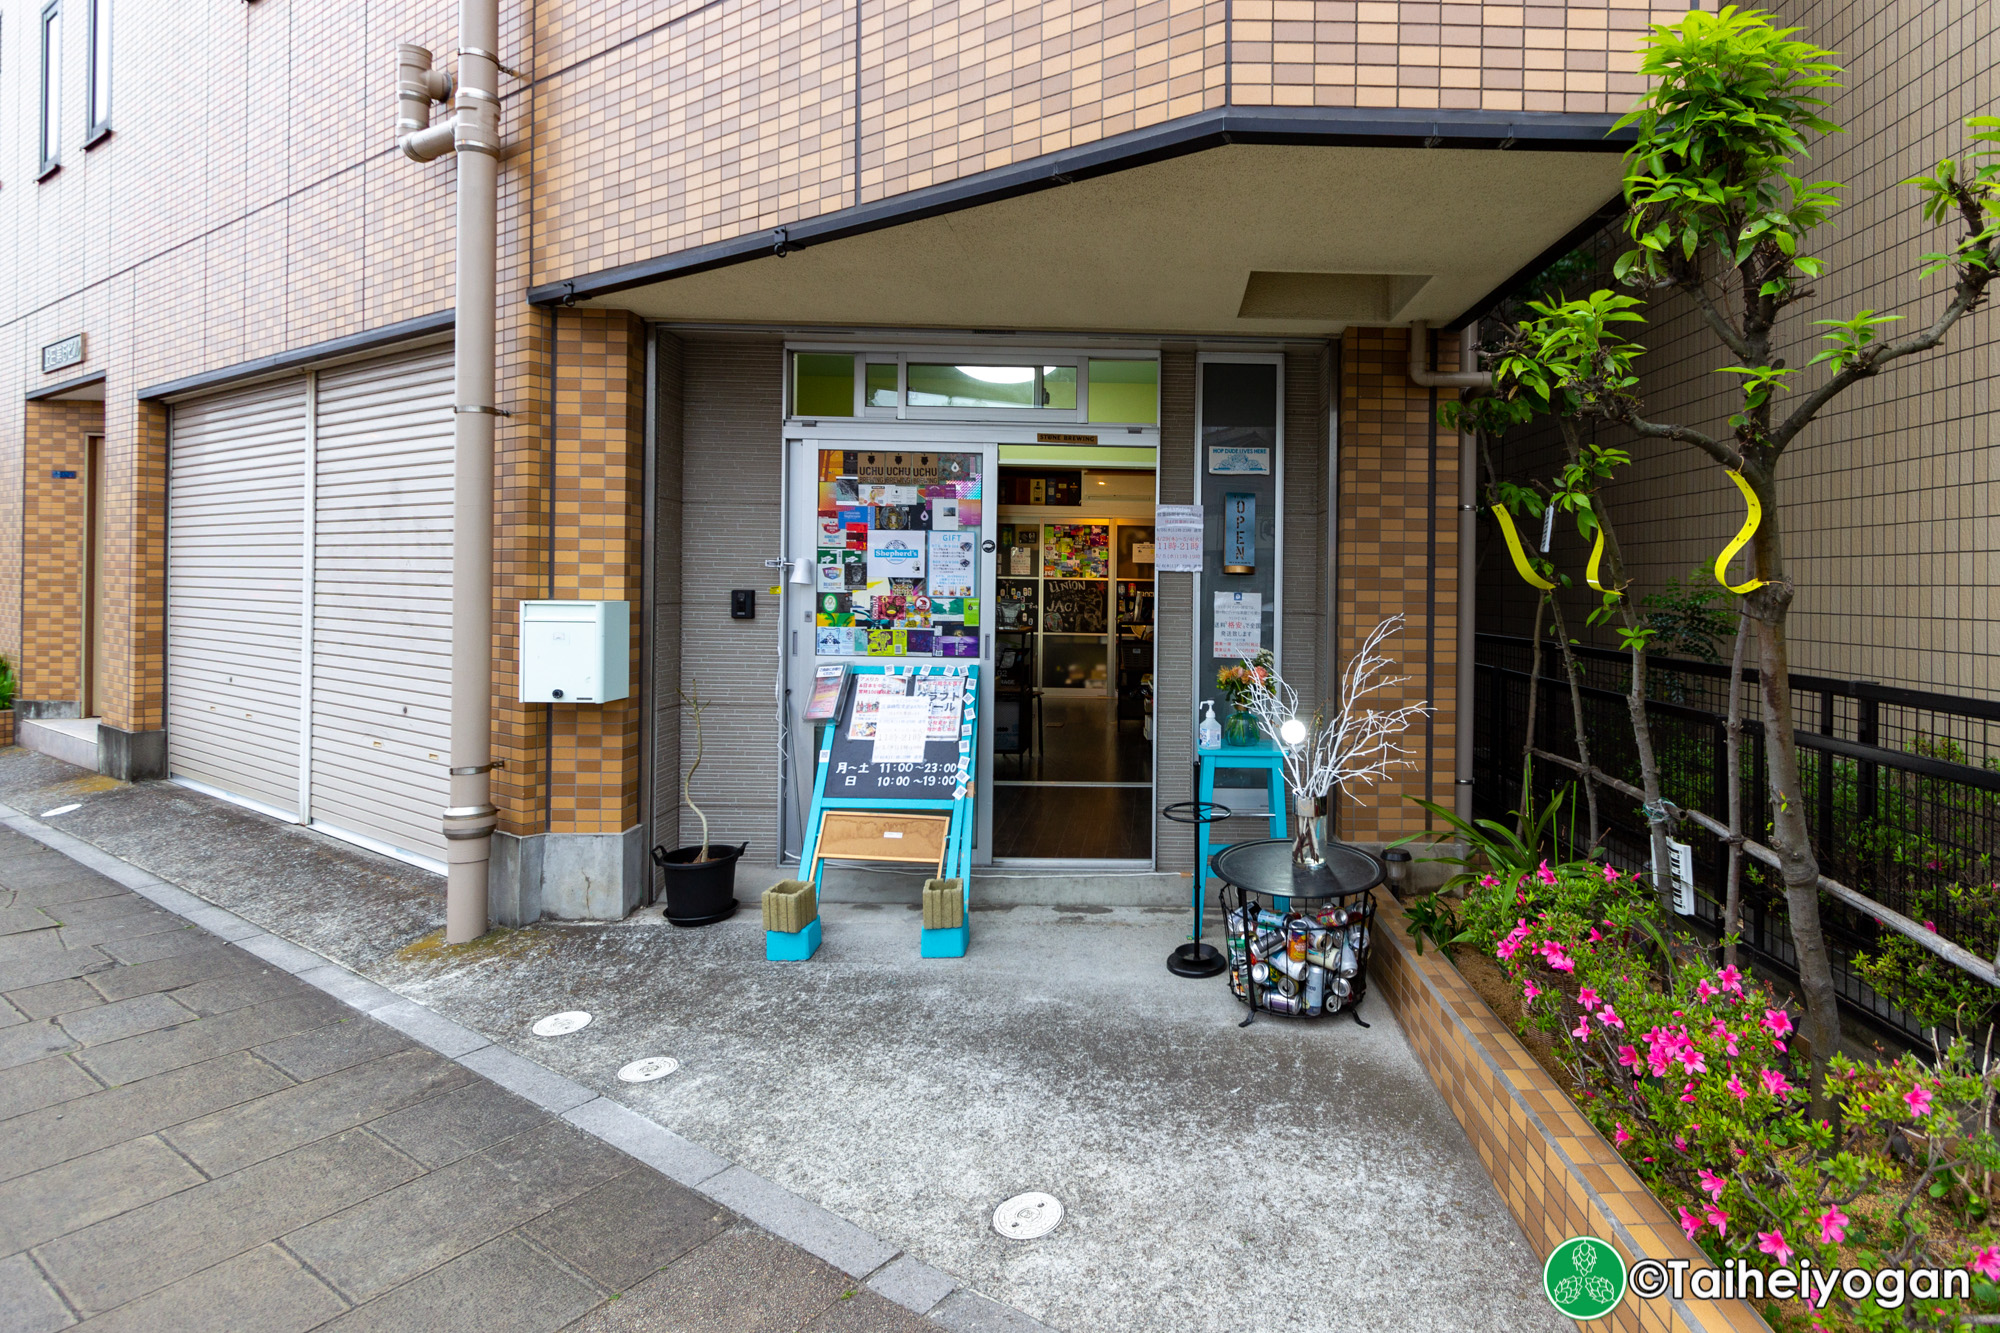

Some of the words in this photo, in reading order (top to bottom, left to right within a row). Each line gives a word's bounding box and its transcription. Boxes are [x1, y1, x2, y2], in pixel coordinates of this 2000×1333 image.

[859, 466, 884, 475] UCHU
[886, 466, 911, 476] UCHU
[913, 467, 938, 477] UCHU
[1236, 500, 1245, 560] OPEN
[942, 534, 962, 542] GIFT
[875, 549, 918, 558] Shepherd's
[1049, 580, 1086, 593] UNION
[844, 775, 857, 787] 日
